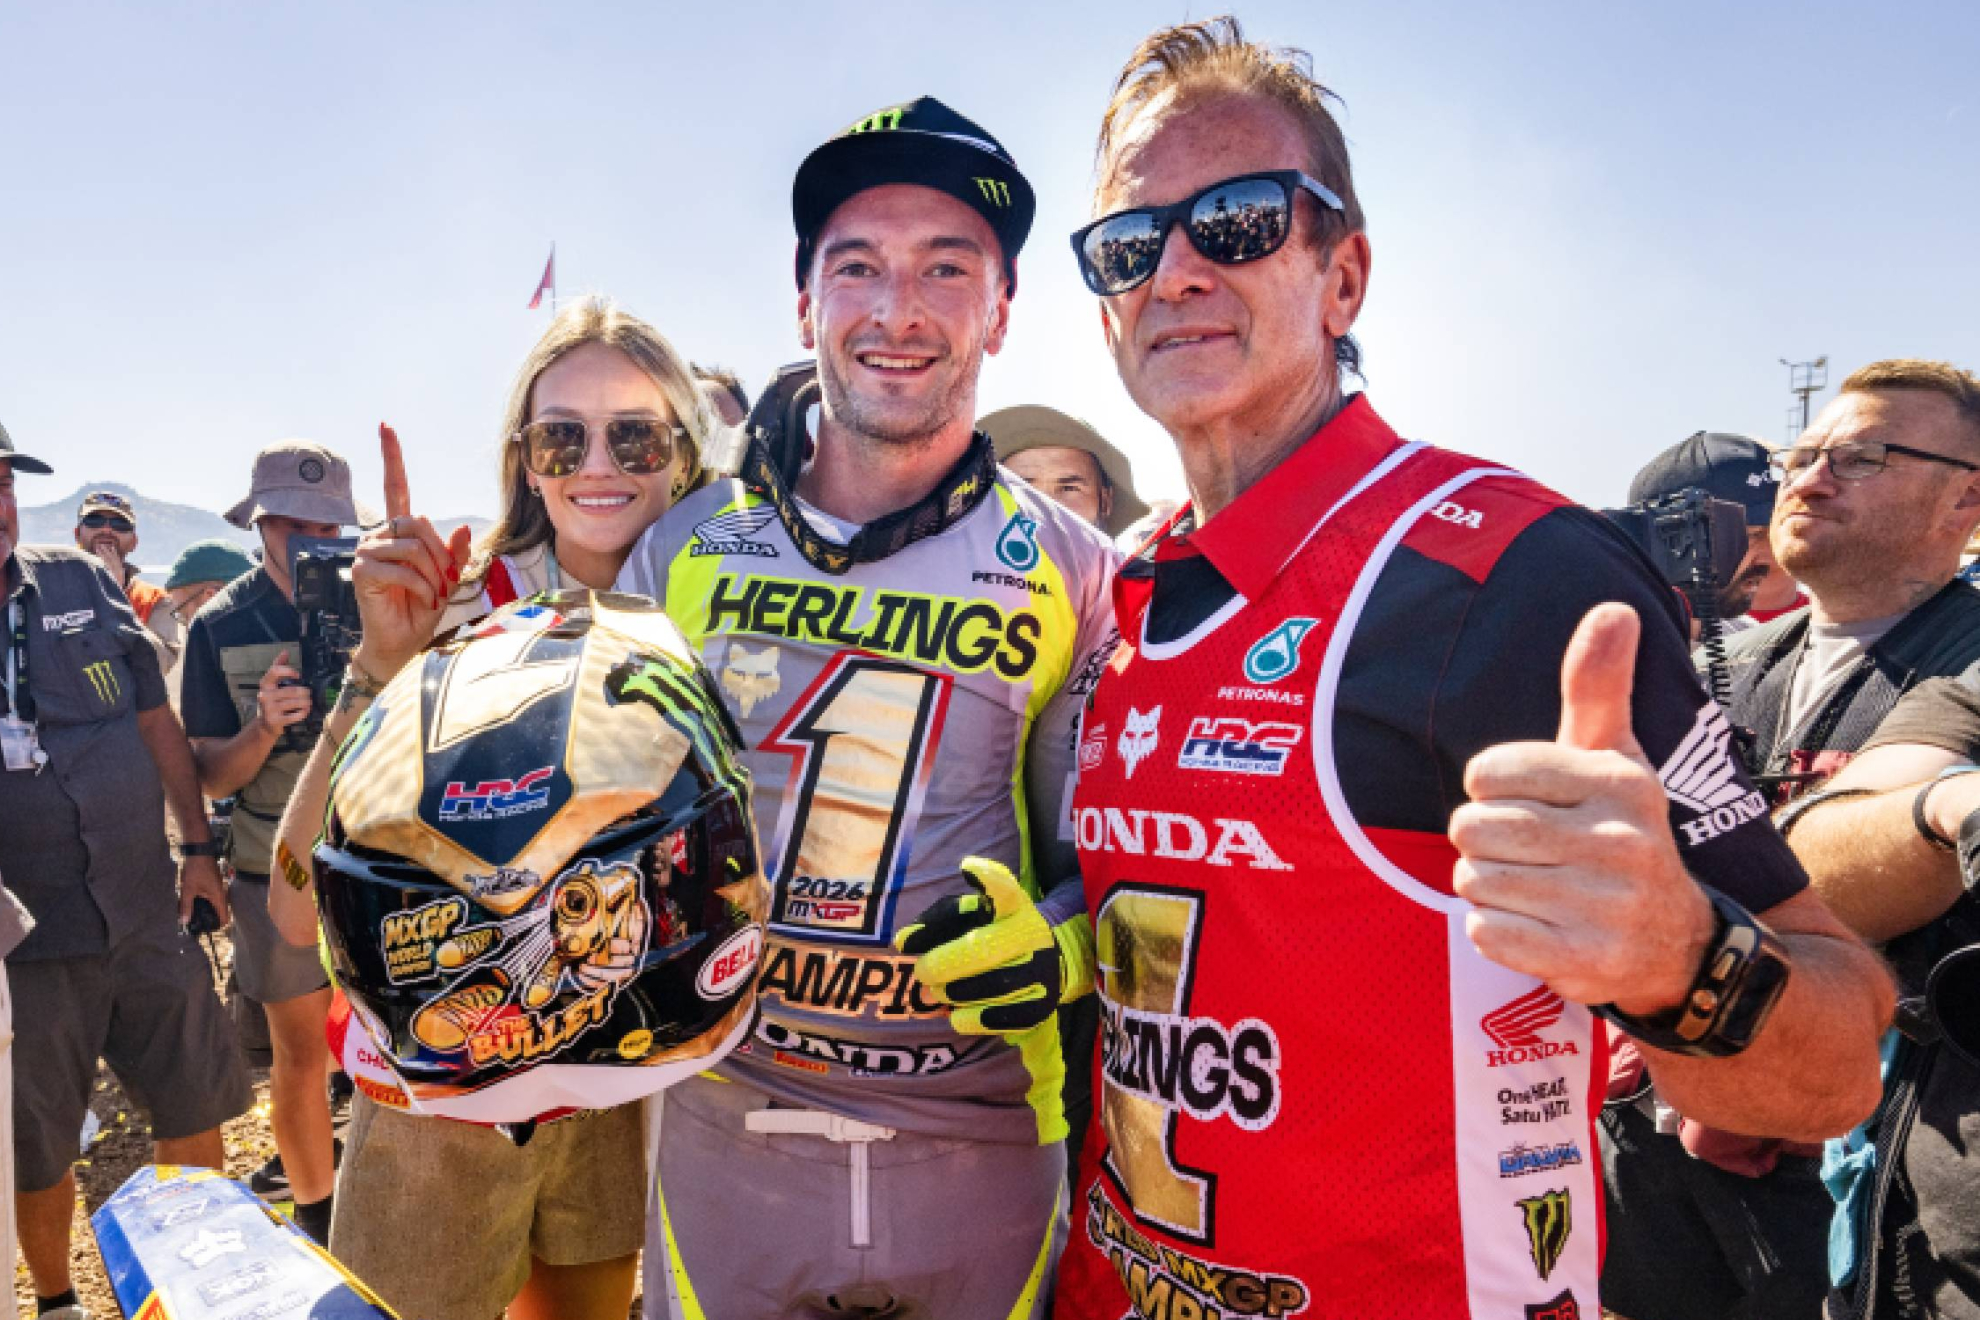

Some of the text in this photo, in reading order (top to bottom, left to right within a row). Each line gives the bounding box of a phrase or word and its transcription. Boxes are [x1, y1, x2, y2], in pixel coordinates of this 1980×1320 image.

[704, 577, 1042, 677] HERLINGS
[1217, 686, 1305, 706] PETRONAS
[439, 765, 556, 812] HRC
[1073, 806, 1296, 872] ONDA
[793, 876, 864, 901] 2026
[385, 902, 460, 949] MXGP
[710, 936, 757, 987] BELL
[471, 985, 610, 1063] BULLET
[1486, 1040, 1580, 1068] HONDA
[1162, 1249, 1308, 1318] MXGP
